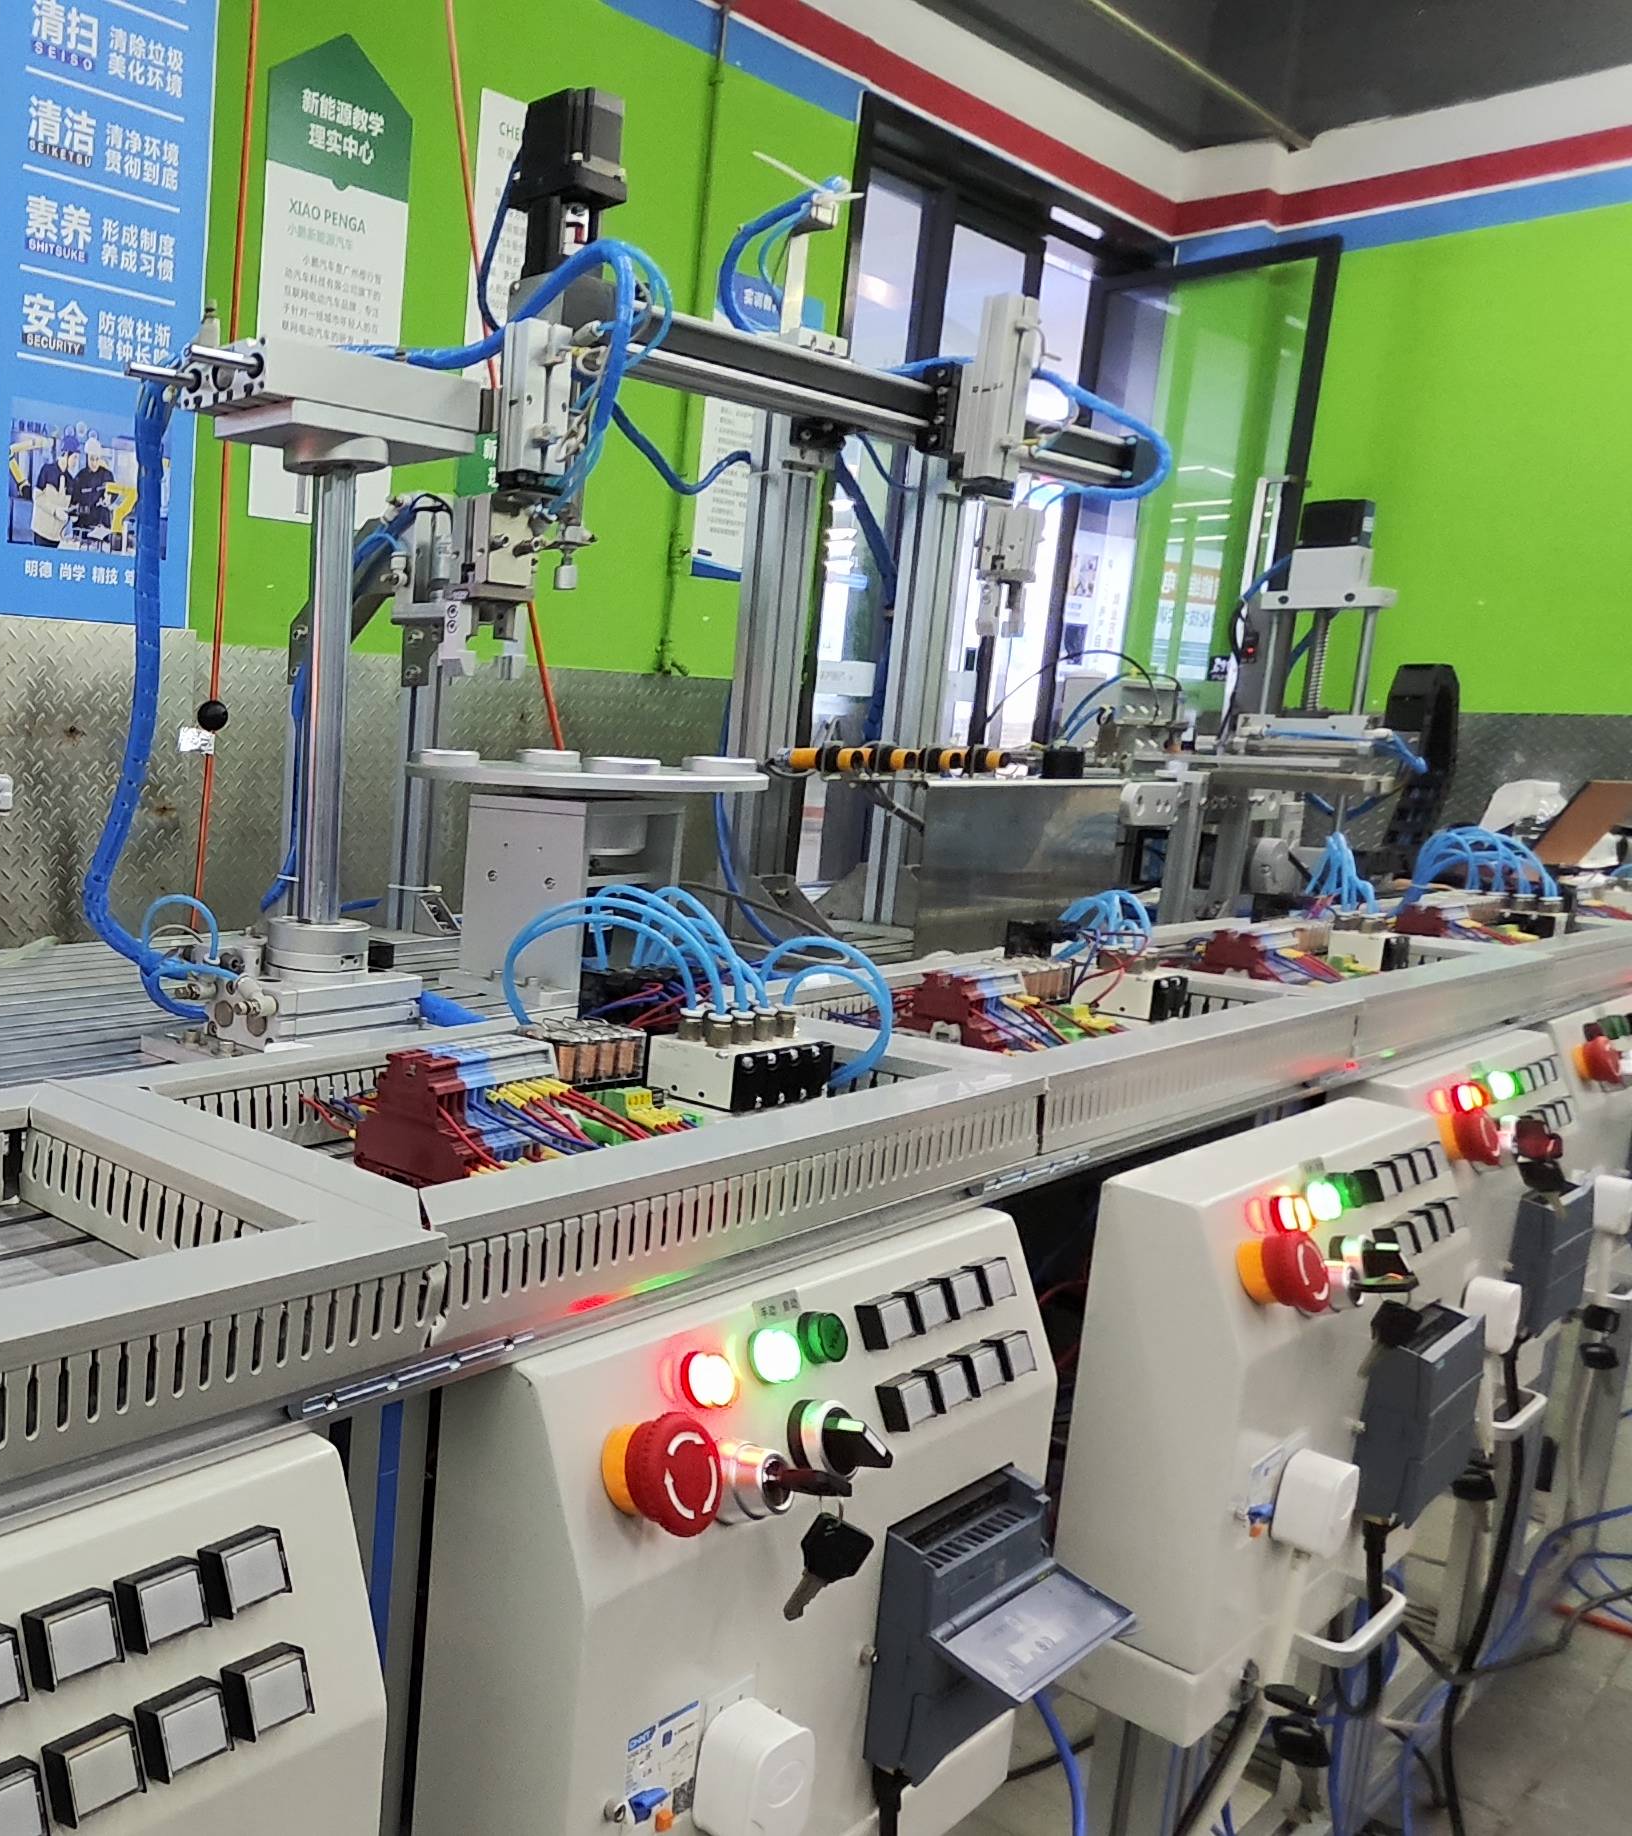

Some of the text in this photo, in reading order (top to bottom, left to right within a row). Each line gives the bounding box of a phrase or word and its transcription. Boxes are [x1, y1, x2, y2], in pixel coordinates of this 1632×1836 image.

[31, 0, 99, 58] 清扫
[109, 25, 184, 75] 清除垃圾
[34, 41, 94, 72] SEISO
[108, 52, 183, 99] 美化环境
[28, 95, 97, 157] 清洁
[302, 87, 385, 137] 新能源教学
[106, 122, 180, 168] 清净环境
[308, 122, 375, 165] 理实中心
[104, 149, 179, 191] 贯彻到底
[25, 195, 92, 250] 素养
[289, 198, 366, 234] XIAO PENGA
[102, 217, 176, 259] 形成制度
[101, 242, 174, 283] 养成习惯
[22, 292, 89, 345] 安全
[98, 310, 171, 348] 防微杜渐
[26, 333, 81, 356] SECURITY
[24, 559, 53, 579] 明德
[59, 562, 86, 582] 尚学
